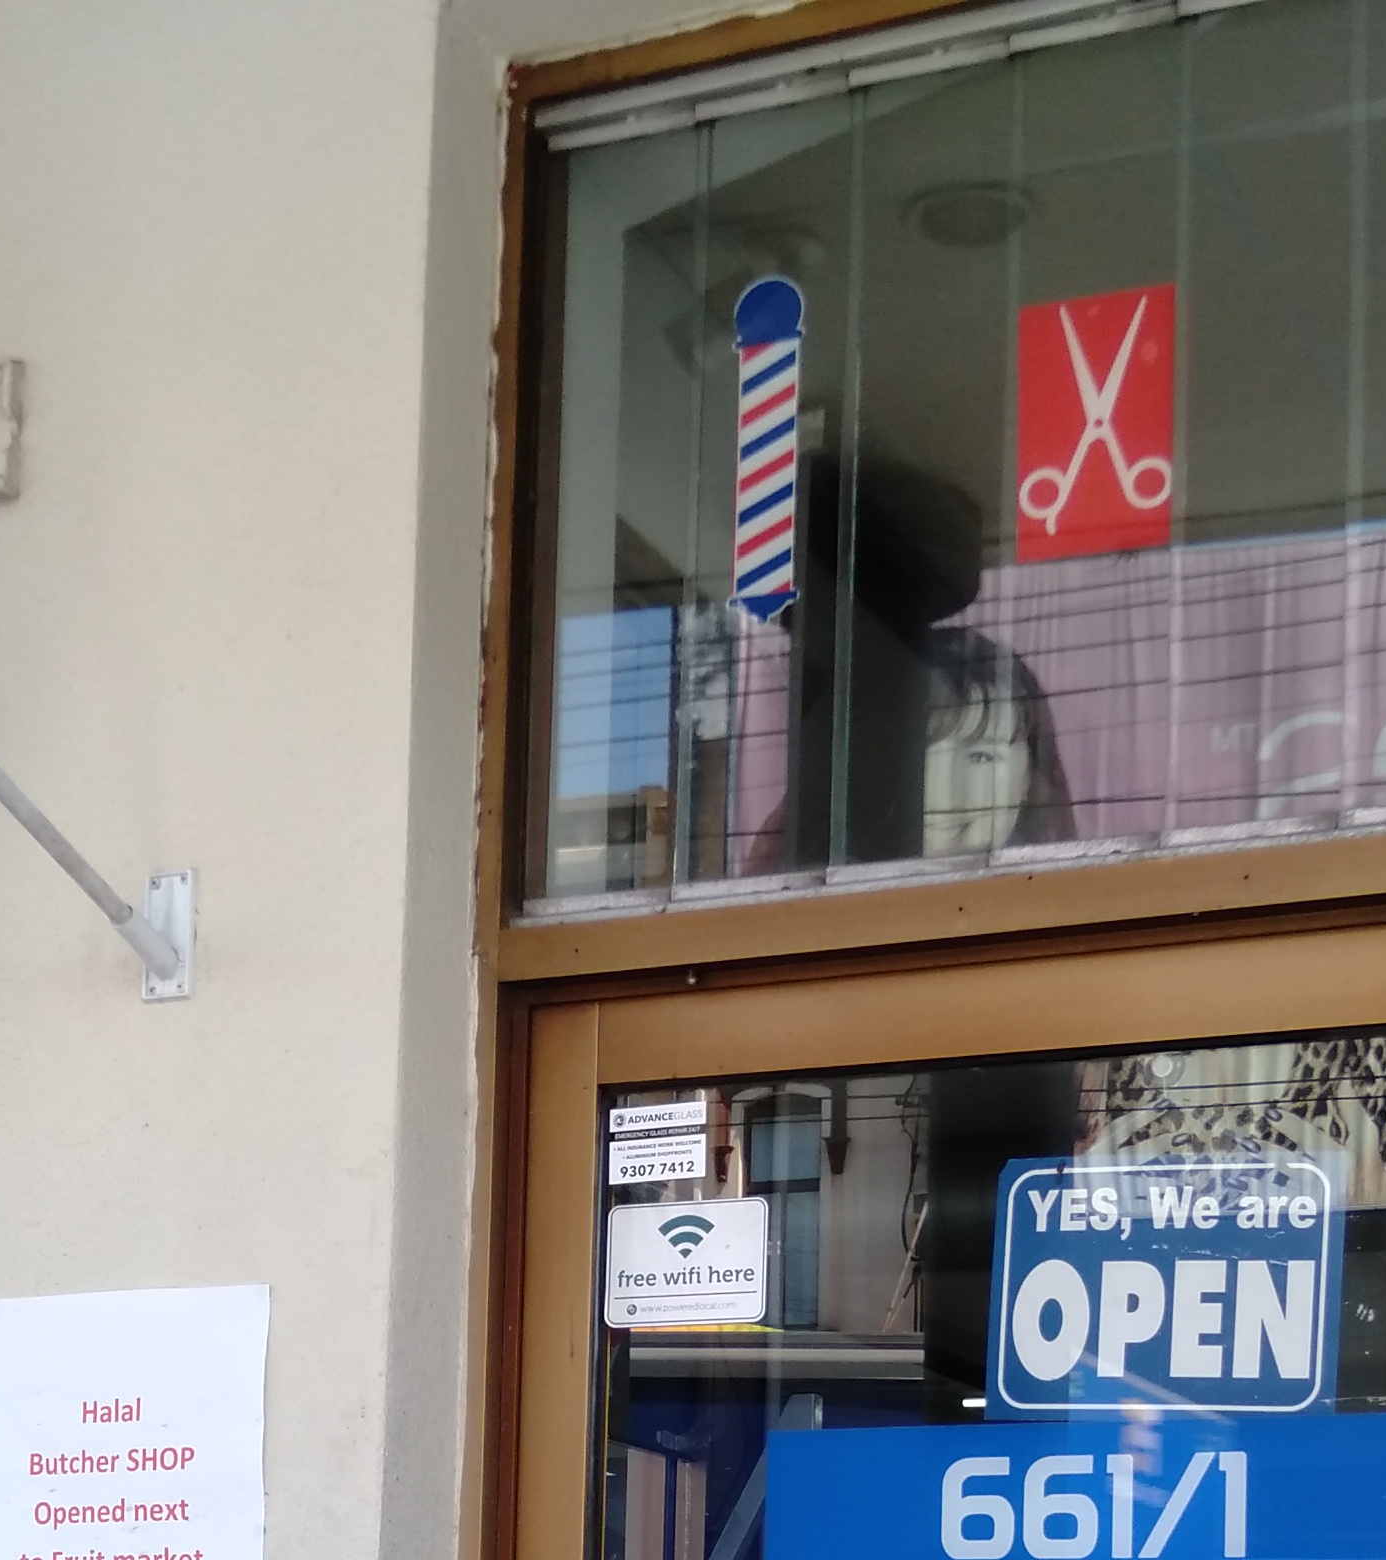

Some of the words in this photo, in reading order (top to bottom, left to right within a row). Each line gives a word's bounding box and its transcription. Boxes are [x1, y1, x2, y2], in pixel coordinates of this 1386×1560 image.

[619, 1163, 655, 1178] 9307
[659, 1160, 695, 1175] 7412
[1028, 1187, 1133, 1241] YES,
[1149, 1186, 1220, 1230] We
[1236, 1194, 1317, 1230] are
[617, 1269, 657, 1288] free
[663, 1267, 702, 1286] wifi
[707, 1265, 755, 1284] here
[1012, 1258, 1316, 1381] OPEN
[81, 1397, 142, 1424] Halal
[28, 1451, 120, 1477] Butcher
[125, 1446, 196, 1472] SHOP
[33, 1498, 126, 1530] Opened
[133, 1498, 190, 1523] next
[940, 1450, 1249, 1560] 661/1
